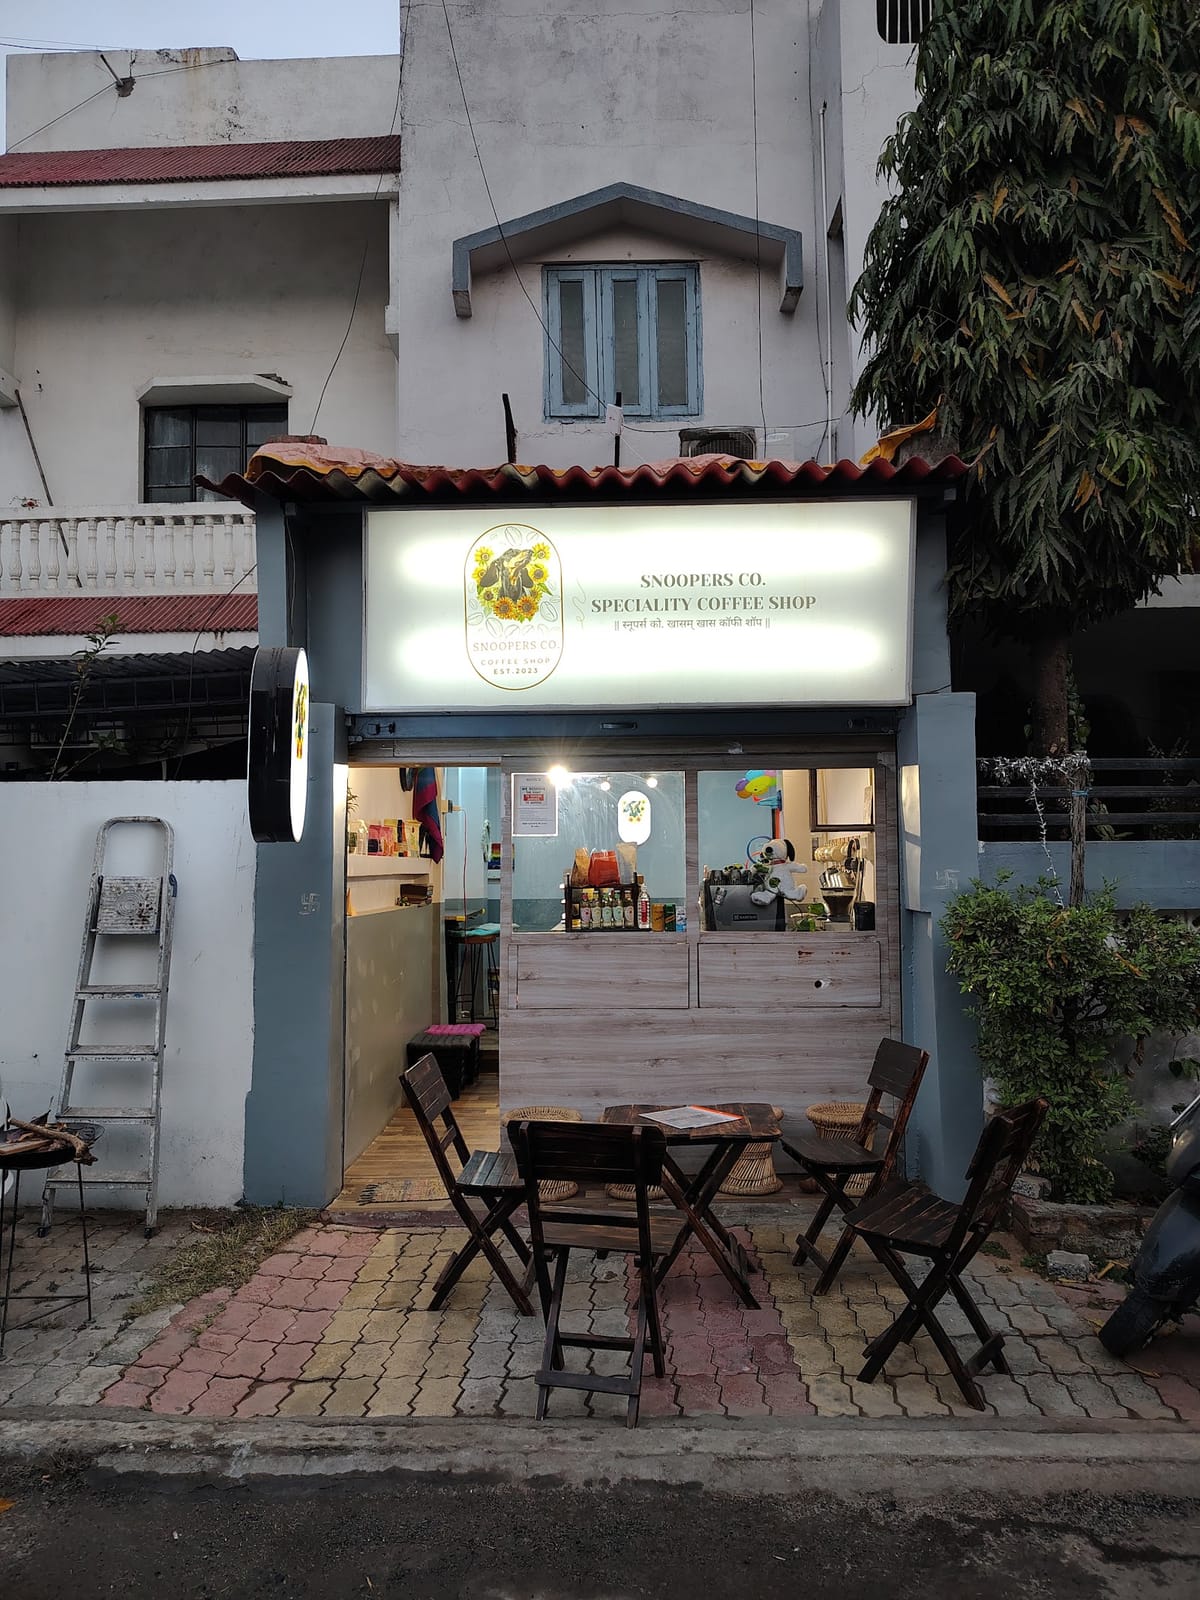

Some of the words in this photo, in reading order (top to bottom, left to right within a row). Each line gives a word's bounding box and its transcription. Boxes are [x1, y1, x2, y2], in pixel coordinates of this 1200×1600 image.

[640, 573, 734, 588] SNOOPERS
[738, 572, 767, 587] CO.
[591, 597, 693, 613] SPECIALITY
[697, 596, 764, 611] COFFEE
[768, 595, 817, 610] SHOP
[696, 619, 716, 628] खास
[719, 616, 743, 627] कॉफी
[745, 616, 763, 627] शॉप
[473, 641, 537, 652] SNOOPERS
[540, 640, 560, 650] CO.
